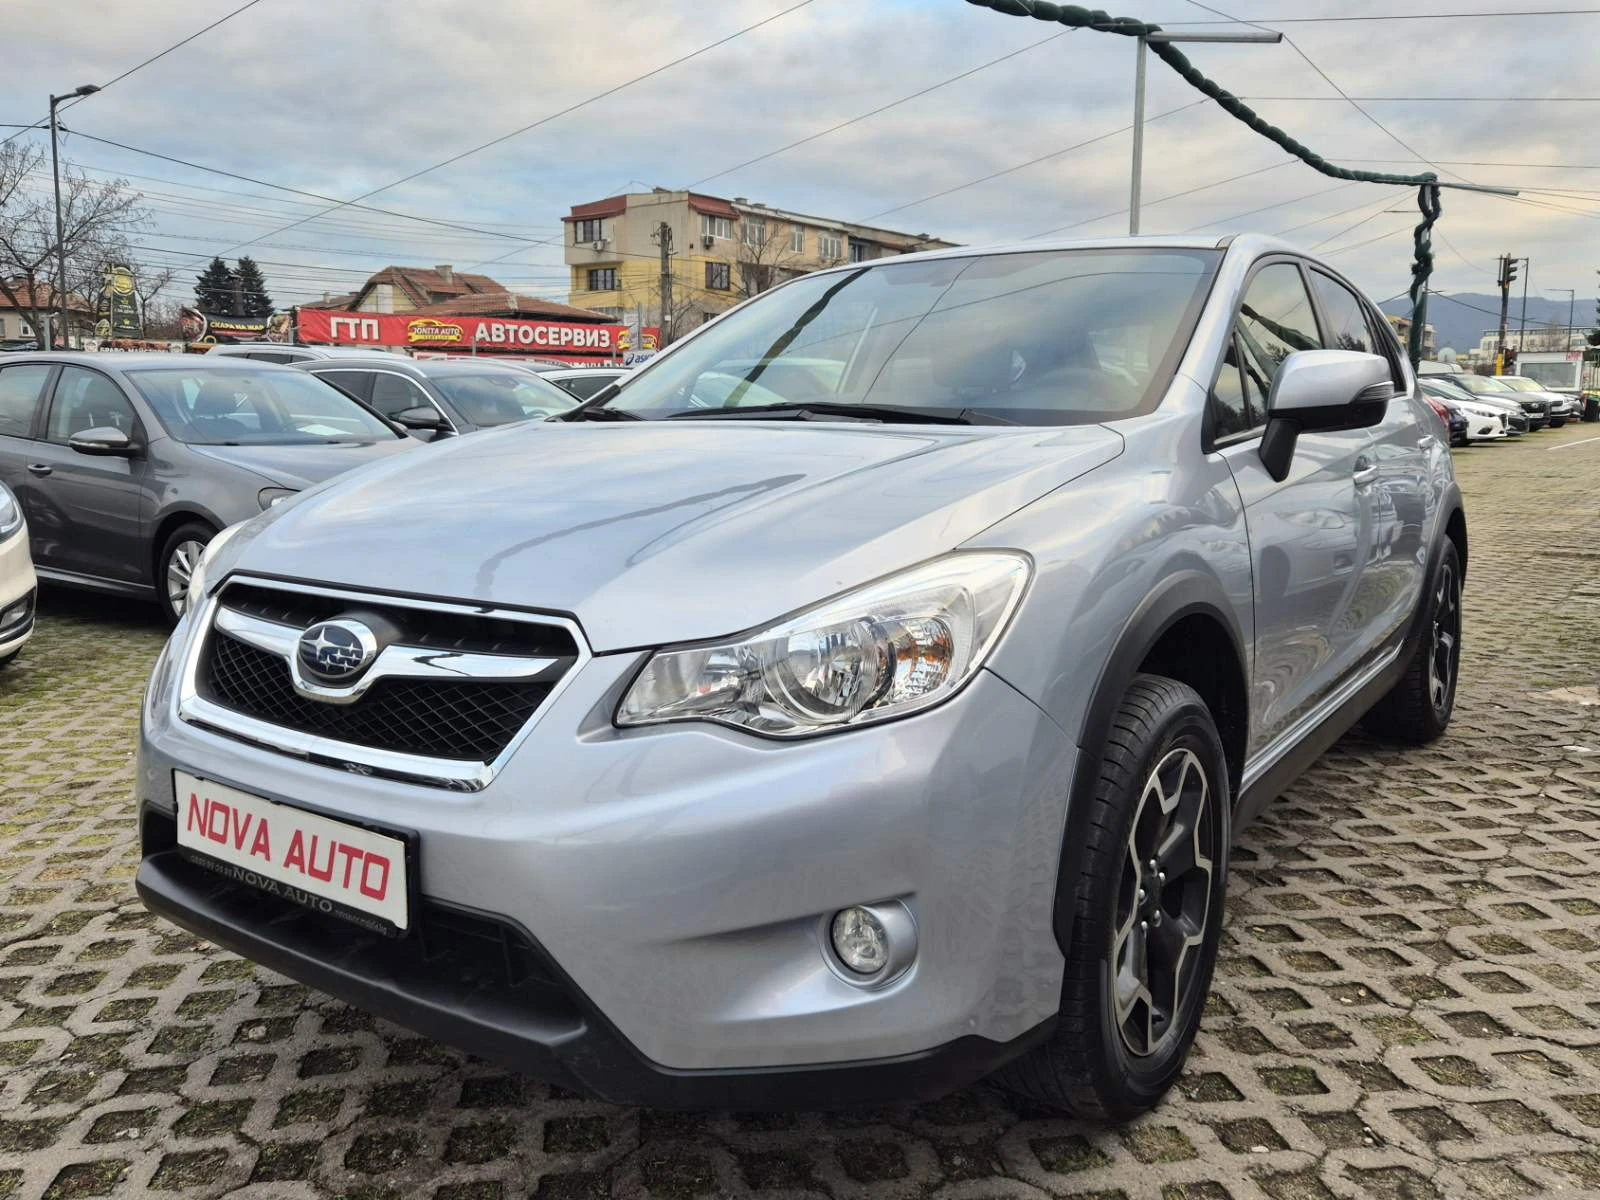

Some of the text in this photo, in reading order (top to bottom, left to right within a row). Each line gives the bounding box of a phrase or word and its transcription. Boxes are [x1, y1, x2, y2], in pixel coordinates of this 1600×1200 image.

[330, 316, 380, 340] ГТП
[440, 328, 460, 337] AUTO
[475, 322, 611, 349] АВТОСЕРВИЗ
[187, 792, 391, 902] NOVA AUTO
[231, 866, 281, 895] NOVA
[283, 887, 334, 914] AUTO
